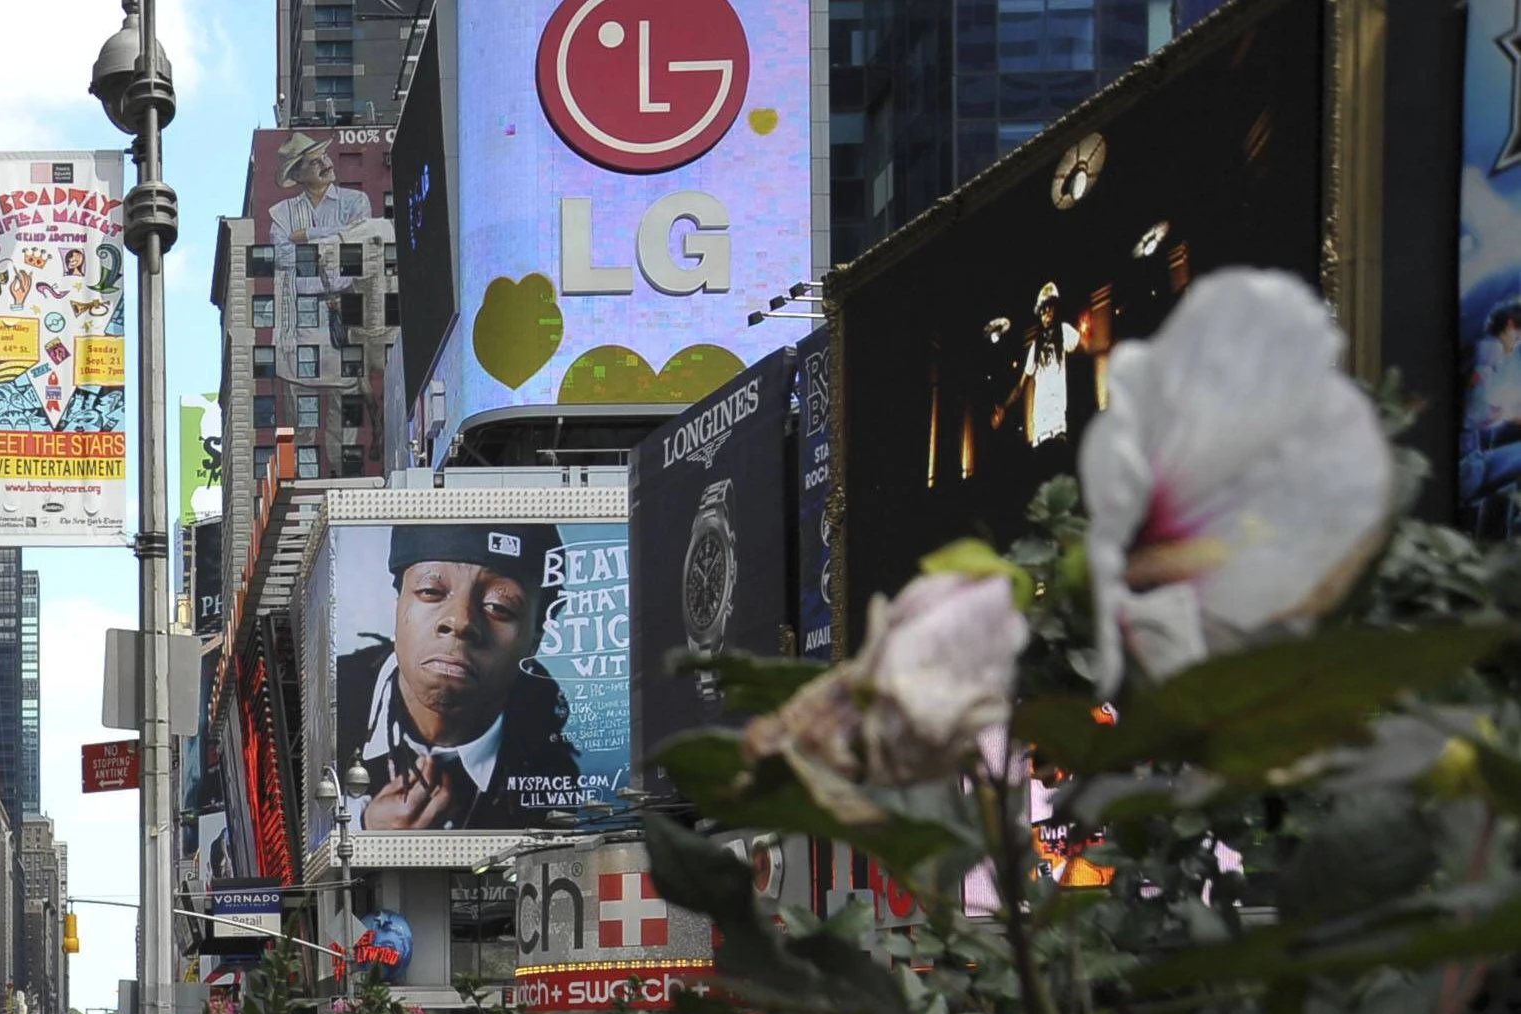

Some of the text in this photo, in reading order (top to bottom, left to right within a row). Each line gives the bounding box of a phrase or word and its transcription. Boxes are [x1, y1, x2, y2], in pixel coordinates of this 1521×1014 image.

[339, 130, 380, 144] 100%
[2, 209, 45, 232] FLEA
[53, 208, 125, 237] MARKET
[560, 190, 732, 296] LG
[87, 344, 118, 354] Sunday
[85, 357, 107, 368] Sept.
[81, 367, 100, 375] 10am
[662, 378, 760, 469] LONGINES
[33, 434, 67, 455] THE
[71, 435, 125, 456] STARS
[15, 459, 123, 477] ENTERTAINMENT
[4, 481, 101, 495] www.broadwaycares.org
[540, 545, 629, 588] BEAT
[104, 745, 118, 757] NO
[92, 756, 131, 769] STOPPING
[95, 766, 128, 780] ANYTIME
[520, 789, 596, 807] LIL WAYNE
[214, 894, 280, 904] VORNADO
